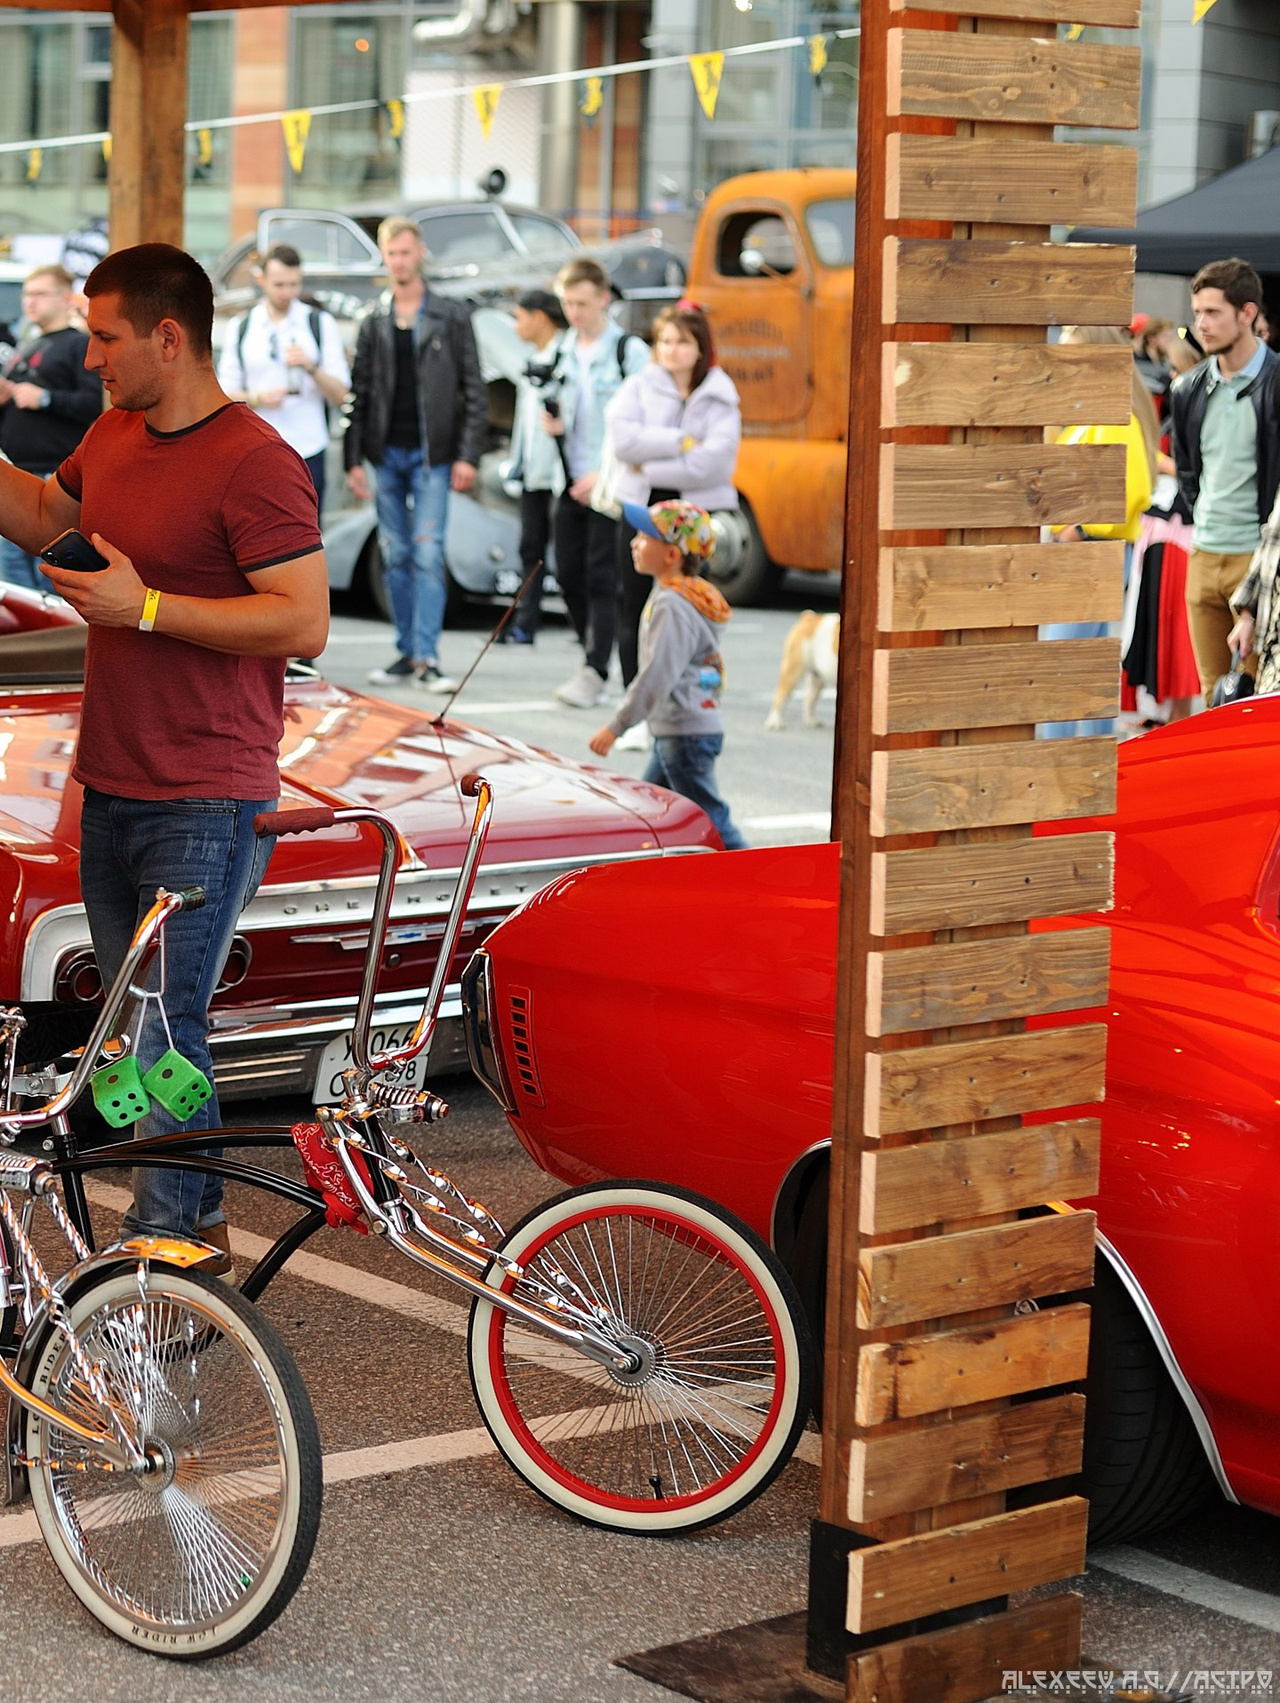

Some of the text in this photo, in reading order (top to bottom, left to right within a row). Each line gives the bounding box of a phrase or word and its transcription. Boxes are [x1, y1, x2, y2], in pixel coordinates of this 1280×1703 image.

[283, 884, 528, 915] CHEROET
[40, 1333, 66, 1384] RIDER
[132, 1625, 177, 1644] RIDER
